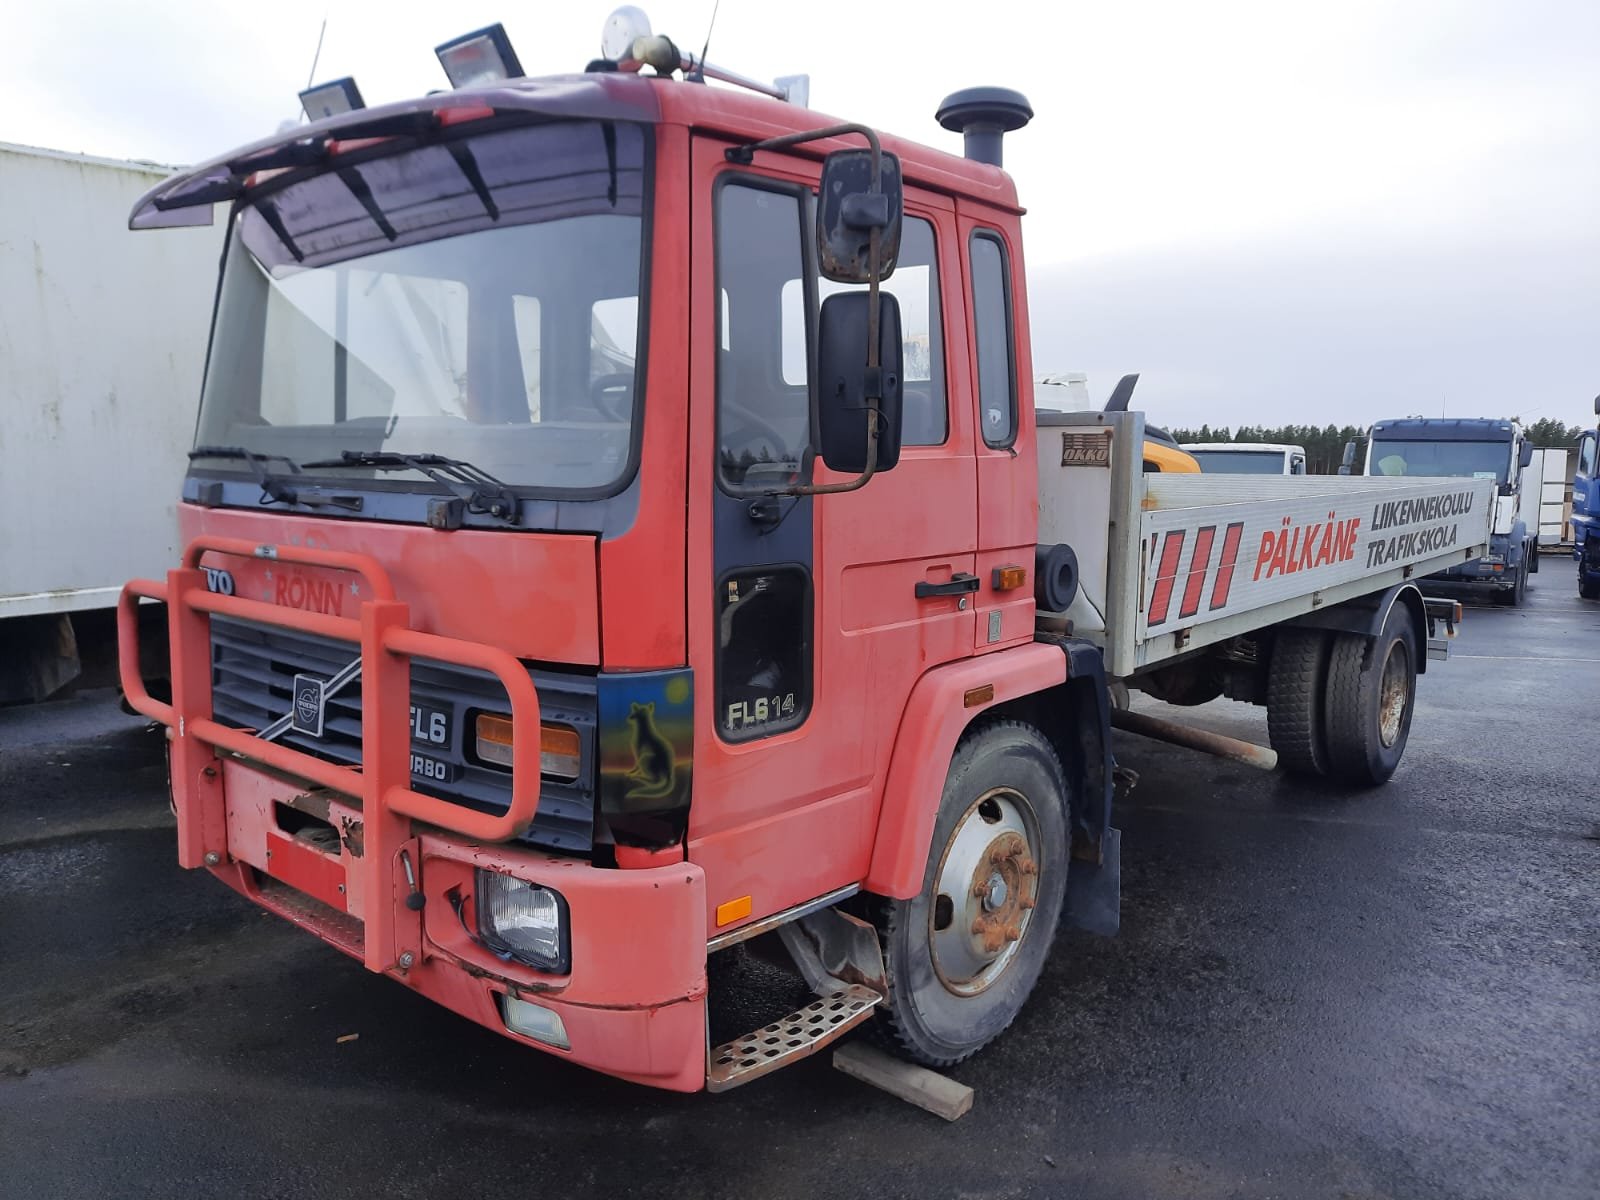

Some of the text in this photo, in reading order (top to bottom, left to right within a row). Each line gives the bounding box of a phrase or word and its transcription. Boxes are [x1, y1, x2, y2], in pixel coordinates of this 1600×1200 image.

[1063, 448, 1107, 461] OKKO
[1371, 491, 1474, 531] LIIKENNEKOULU
[1253, 511, 1360, 581] PÄLKÄNE
[1366, 524, 1457, 568] TRAFIKSKOLA
